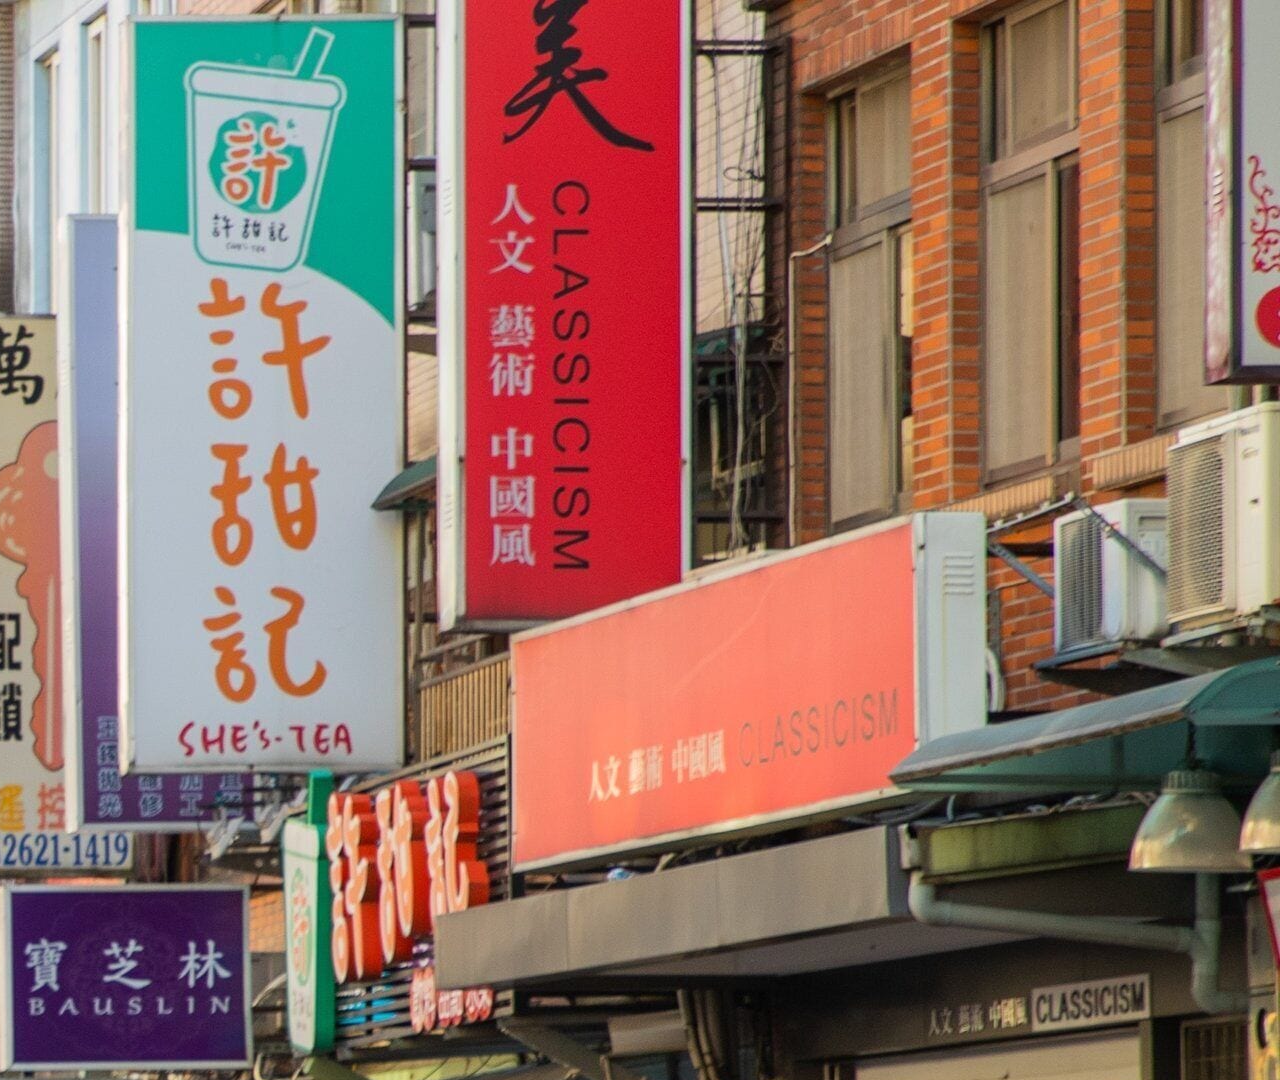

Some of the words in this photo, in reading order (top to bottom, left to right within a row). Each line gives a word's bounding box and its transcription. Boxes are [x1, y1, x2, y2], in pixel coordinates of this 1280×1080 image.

[222, 119, 291, 209] 許
[489, 184, 535, 275] 人文
[488, 304, 536, 398] 藝術
[550, 180, 591, 571] CLASSICISM
[197, 277, 331, 702] 許甜記
[488, 426, 536, 567] 中國風
[587, 757, 622, 803] 人文
[628, 743, 665, 795] 藝術
[670, 728, 727, 784] 中國風
[738, 687, 900, 769] CLASSICISM
[3, 833, 129, 867] 2621-1419
[24, 937, 232, 993] 寶芝林
[28, 997, 232, 1017] BAUSLIN
[1034, 979, 1147, 1025] CLASSICISM
